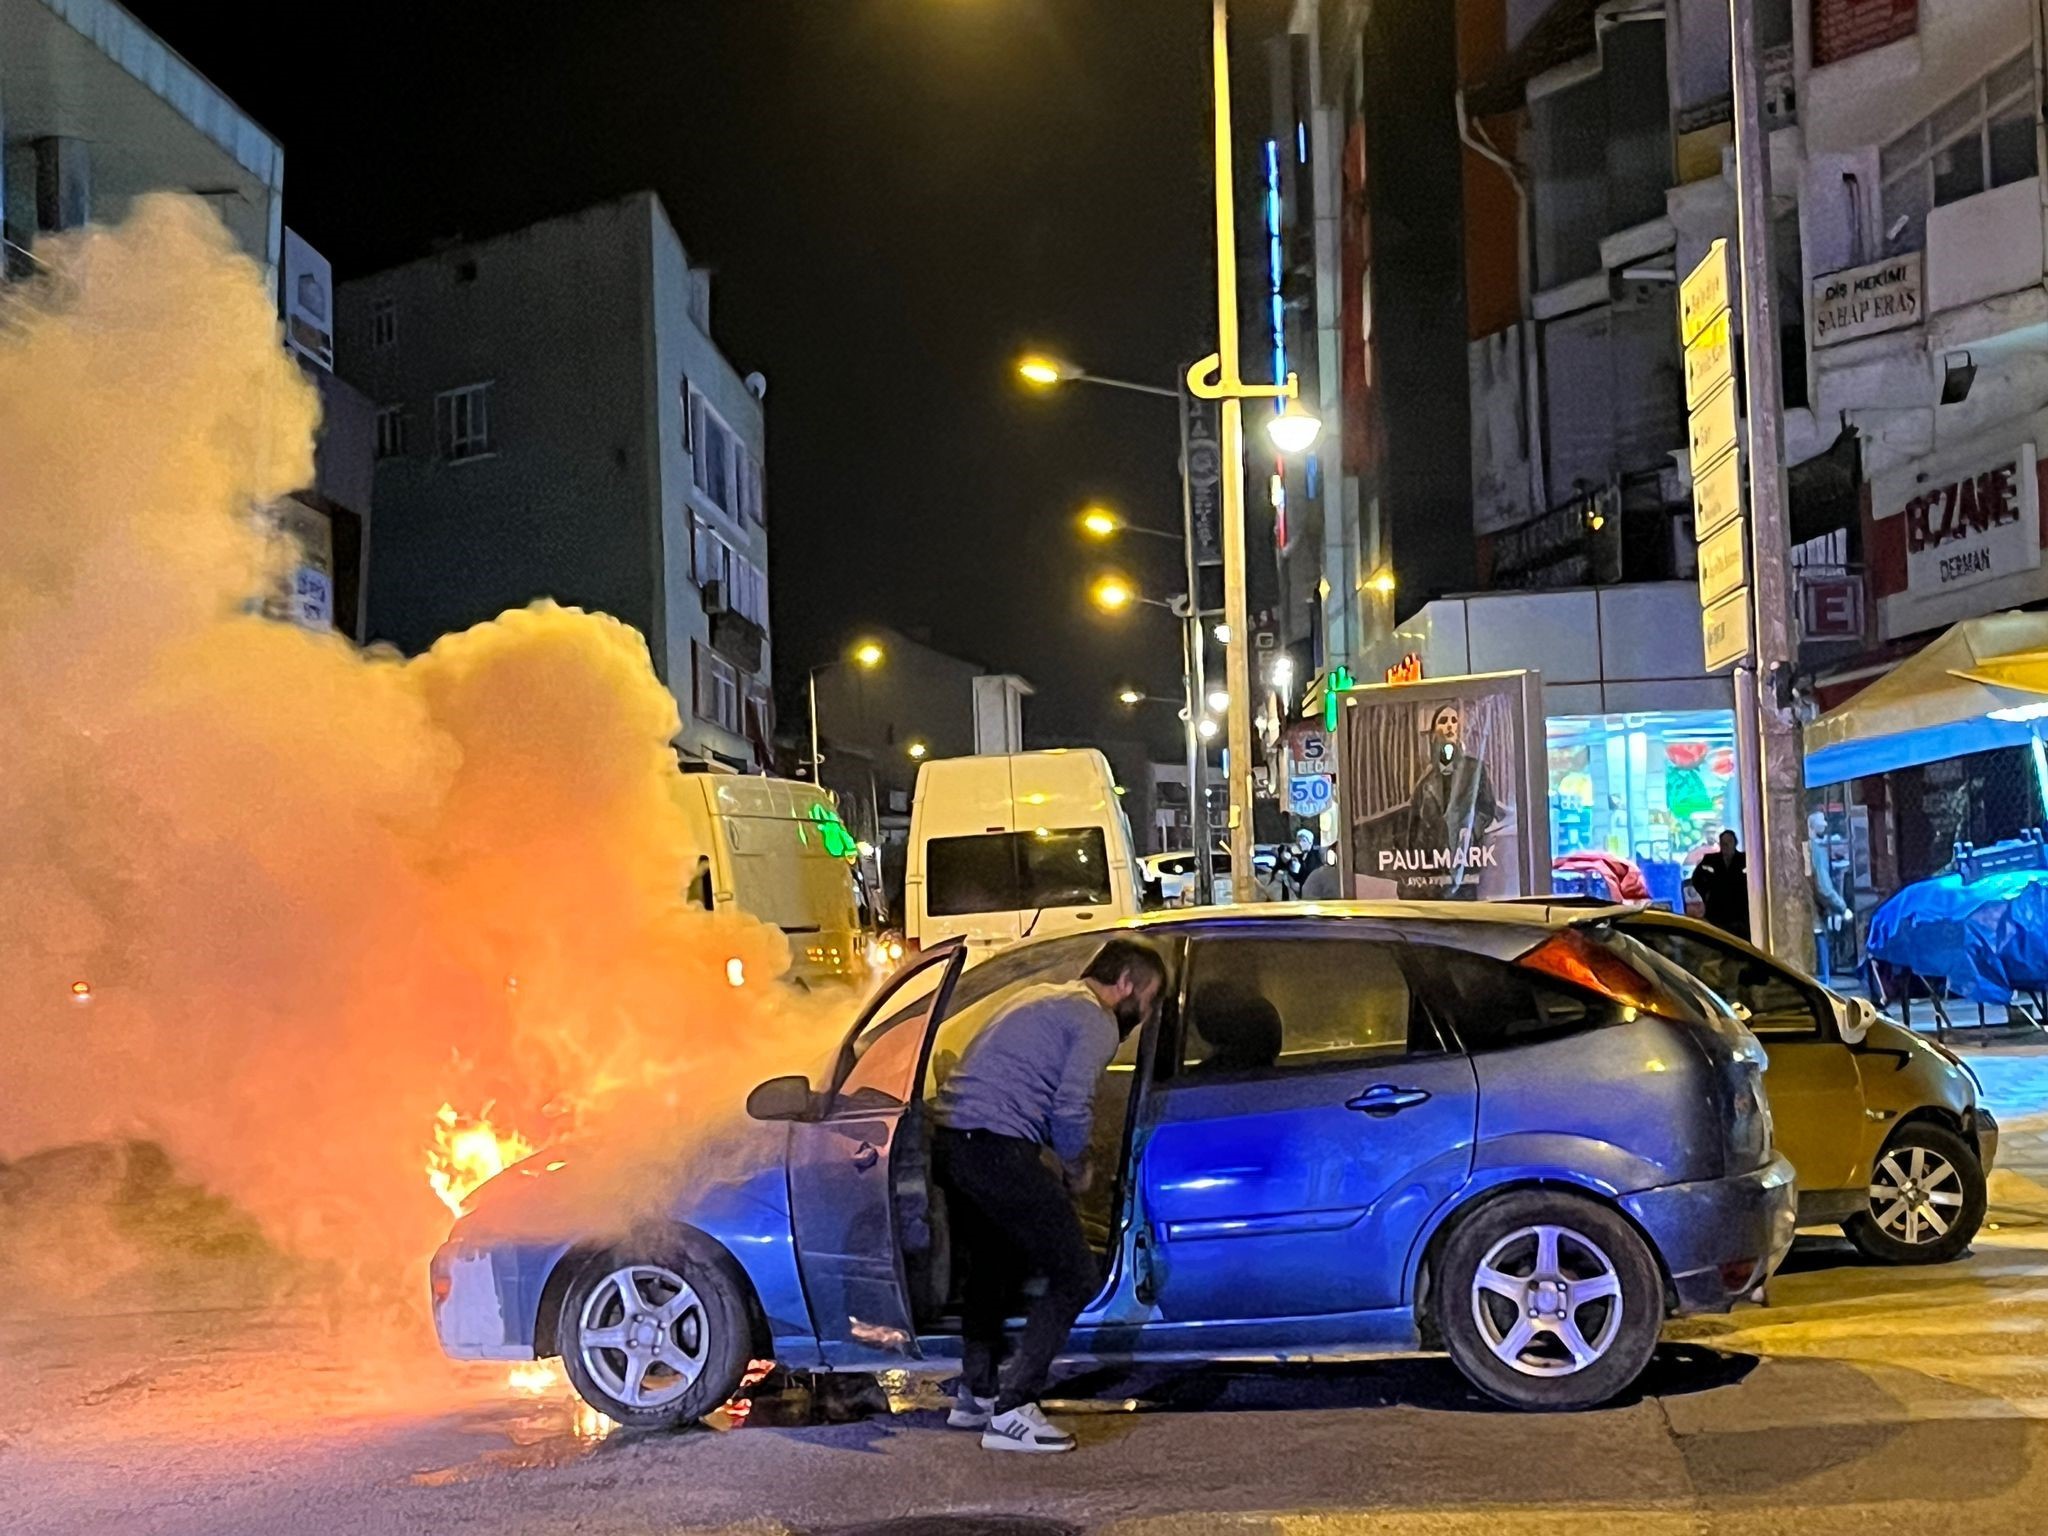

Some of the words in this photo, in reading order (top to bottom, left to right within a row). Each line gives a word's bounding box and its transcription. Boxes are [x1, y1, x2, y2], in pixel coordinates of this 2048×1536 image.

[1939, 547, 1991, 583] DERMAN
[1305, 738, 1325, 759] 5
[1292, 780, 1329, 801] 50
[1378, 844, 1498, 871] PAULMARK
